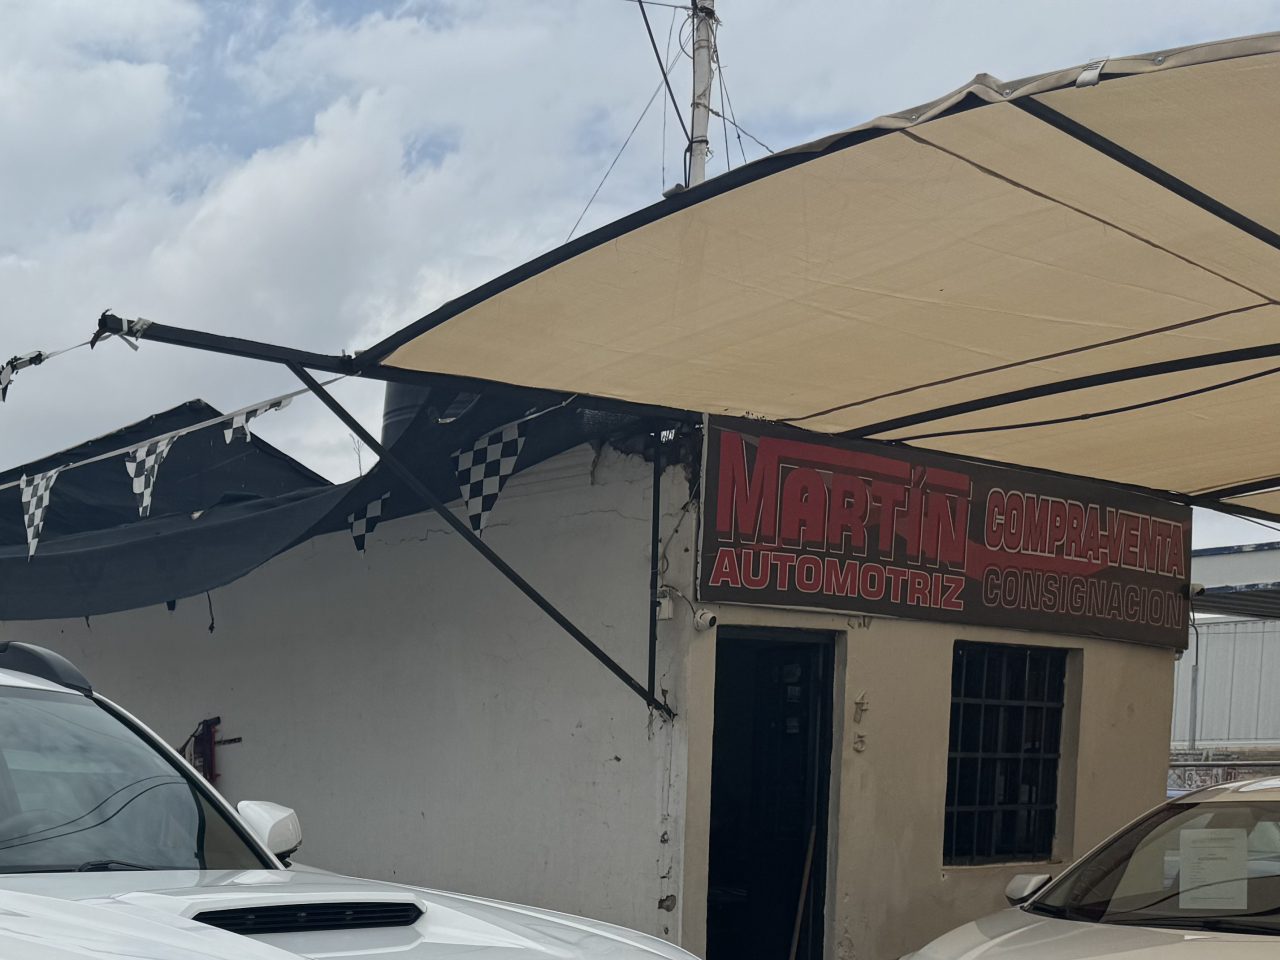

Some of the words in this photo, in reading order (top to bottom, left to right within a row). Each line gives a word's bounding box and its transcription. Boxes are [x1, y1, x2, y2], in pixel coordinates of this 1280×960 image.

[984, 488, 1185, 579] COMPRA-VENTA
[709, 547, 966, 611] AUTOMOTRIZ
[983, 566, 1184, 628] CONSIGNACION
